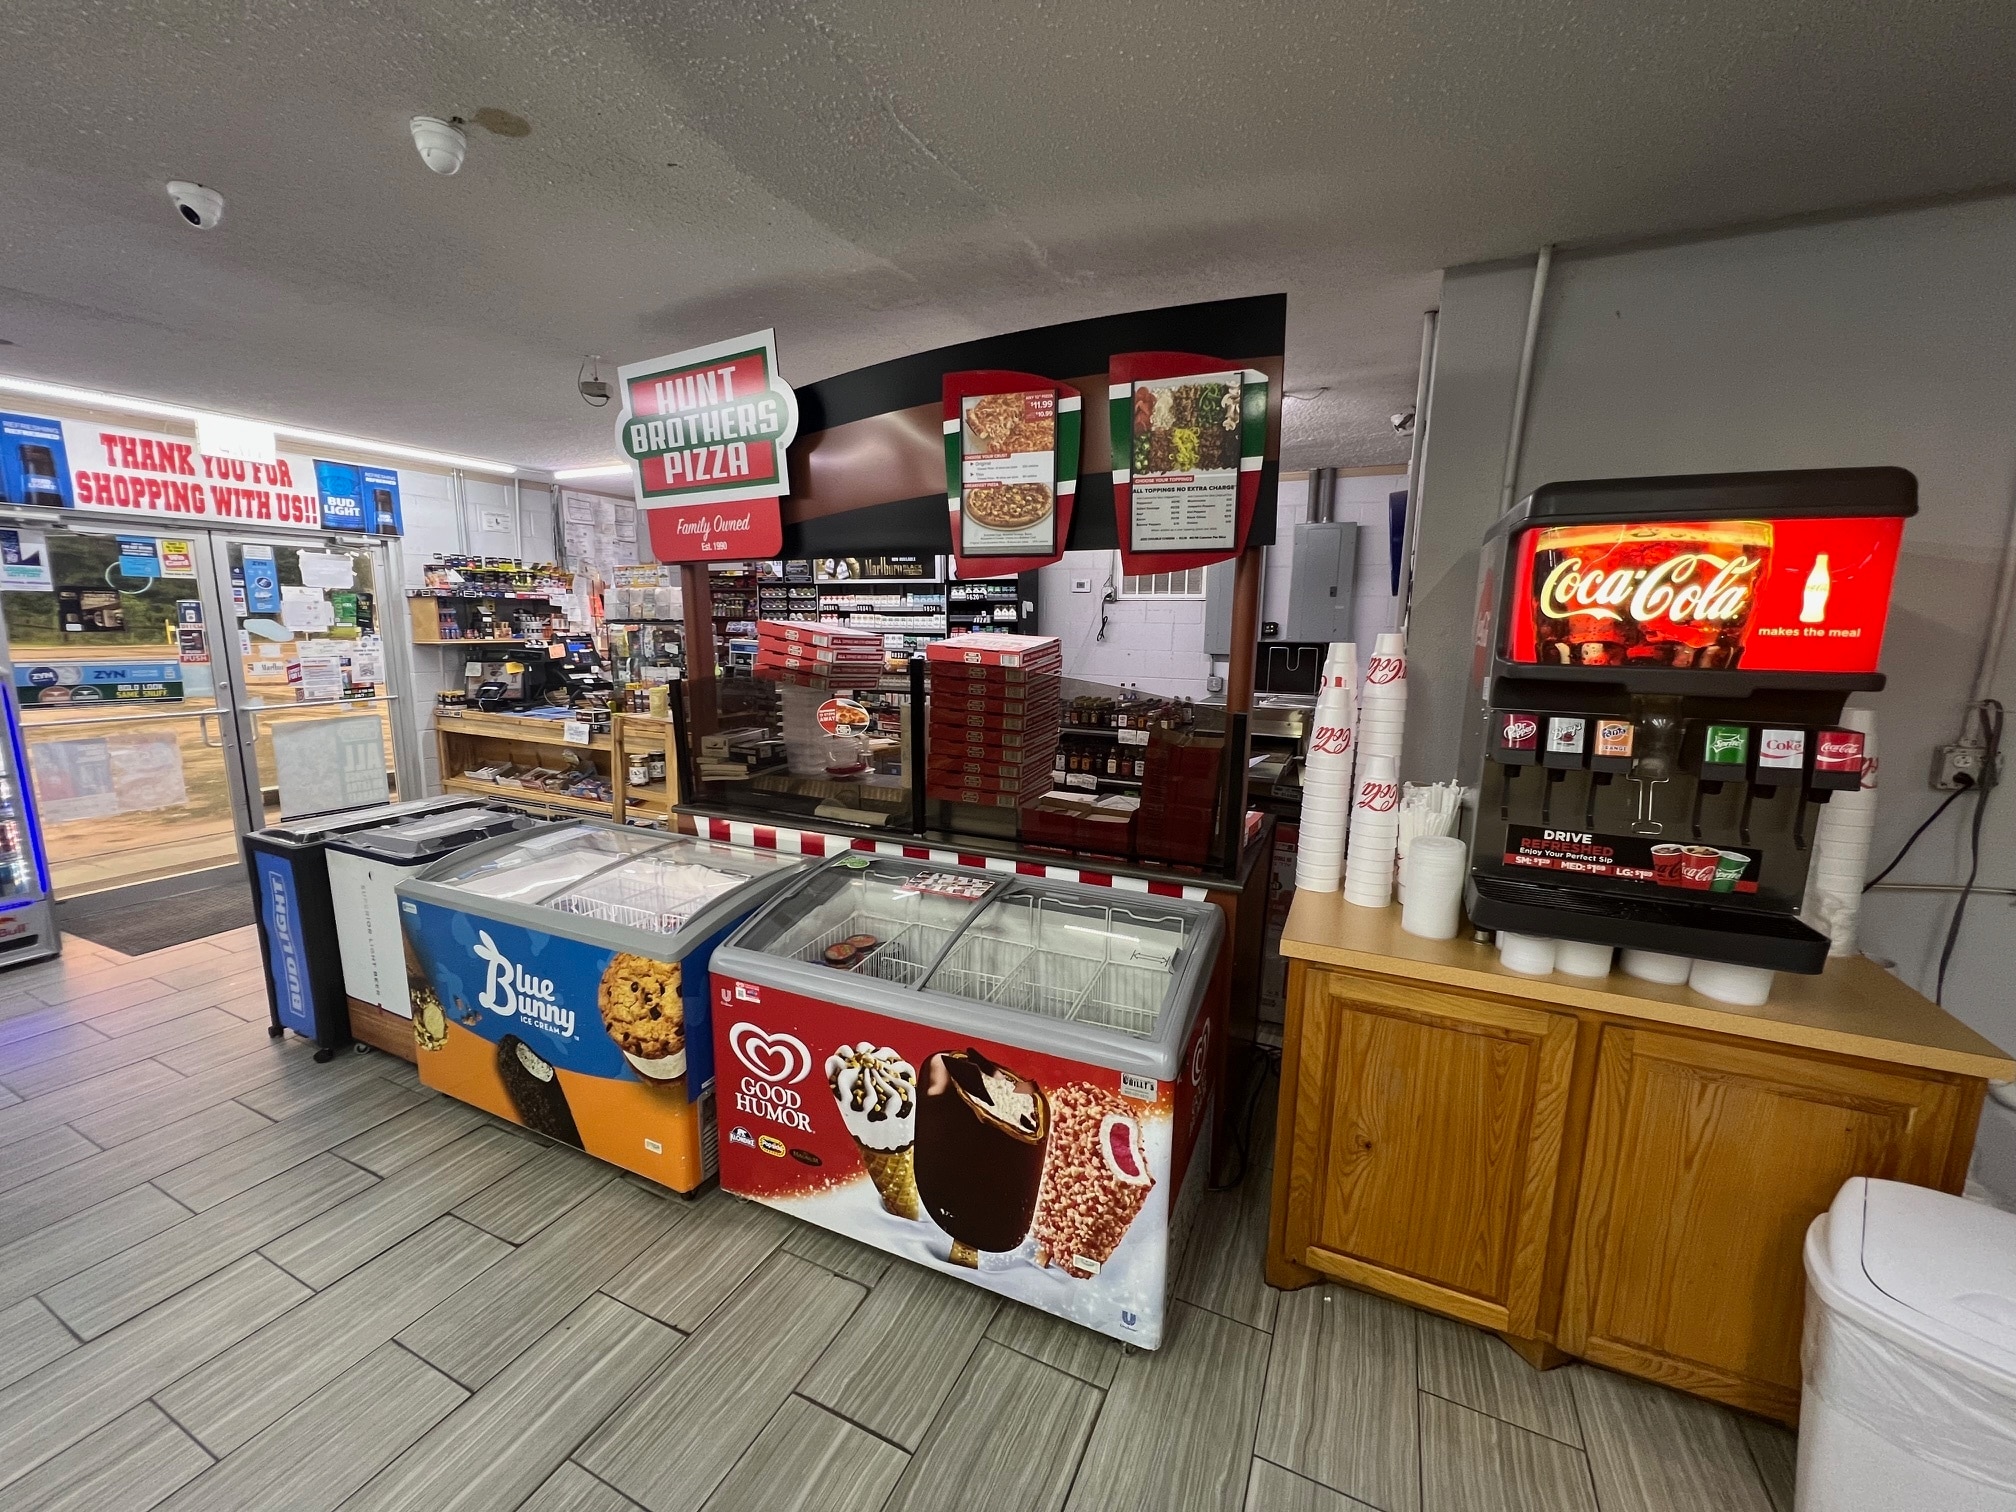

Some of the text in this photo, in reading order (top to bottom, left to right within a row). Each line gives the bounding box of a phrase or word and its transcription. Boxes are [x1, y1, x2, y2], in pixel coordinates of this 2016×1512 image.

[655, 366, 736, 415] HUNT
[1030, 400, 1053, 409] $11.99
[630, 399, 779, 454] BROTHERS
[99, 432, 195, 476] THANK
[201, 455, 245, 482] YOU
[251, 459, 293, 488] FOR
[663, 441, 750, 484] PIZZA
[75, 470, 318, 524] SHOPPING WITH US!!
[327, 497, 355, 508] BUD
[324, 504, 361, 517] LIGHT
[677, 512, 751, 541] Family Owned
[701, 541, 727, 551] Est. 1990
[865, 556, 903, 576] Marlboro
[1540, 553, 1761, 622] Coca-Cola
[1758, 626, 1861, 638] makes the meal
[94, 669, 126, 680] ZYN
[1507, 726, 1534, 739] Pepper
[1515, 723, 1527, 731] Dr
[1601, 727, 1627, 739] Fanta
[1714, 738, 1741, 750] Sprite
[1766, 739, 1802, 751] Coke
[1820, 742, 1860, 754] Coca-Cola
[1544, 830, 1593, 844] DRIVE
[1519, 847, 1613, 864] Enjoy Your Perfect Sip
[1521, 838, 1614, 857] REFRESHED
[1515, 856, 1532, 865] SM:
[1561, 862, 1586, 871] MED:
[1616, 867, 1634, 876] LG:
[271, 876, 303, 1012] BUD LIGHT
[360, 885, 381, 996] SUPERIOR LIGHT BEER
[520, 1015, 561, 1036] ICE CREAM
[741, 1076, 801, 1109] GOOD
[735, 1092, 813, 1133] HUMOR
